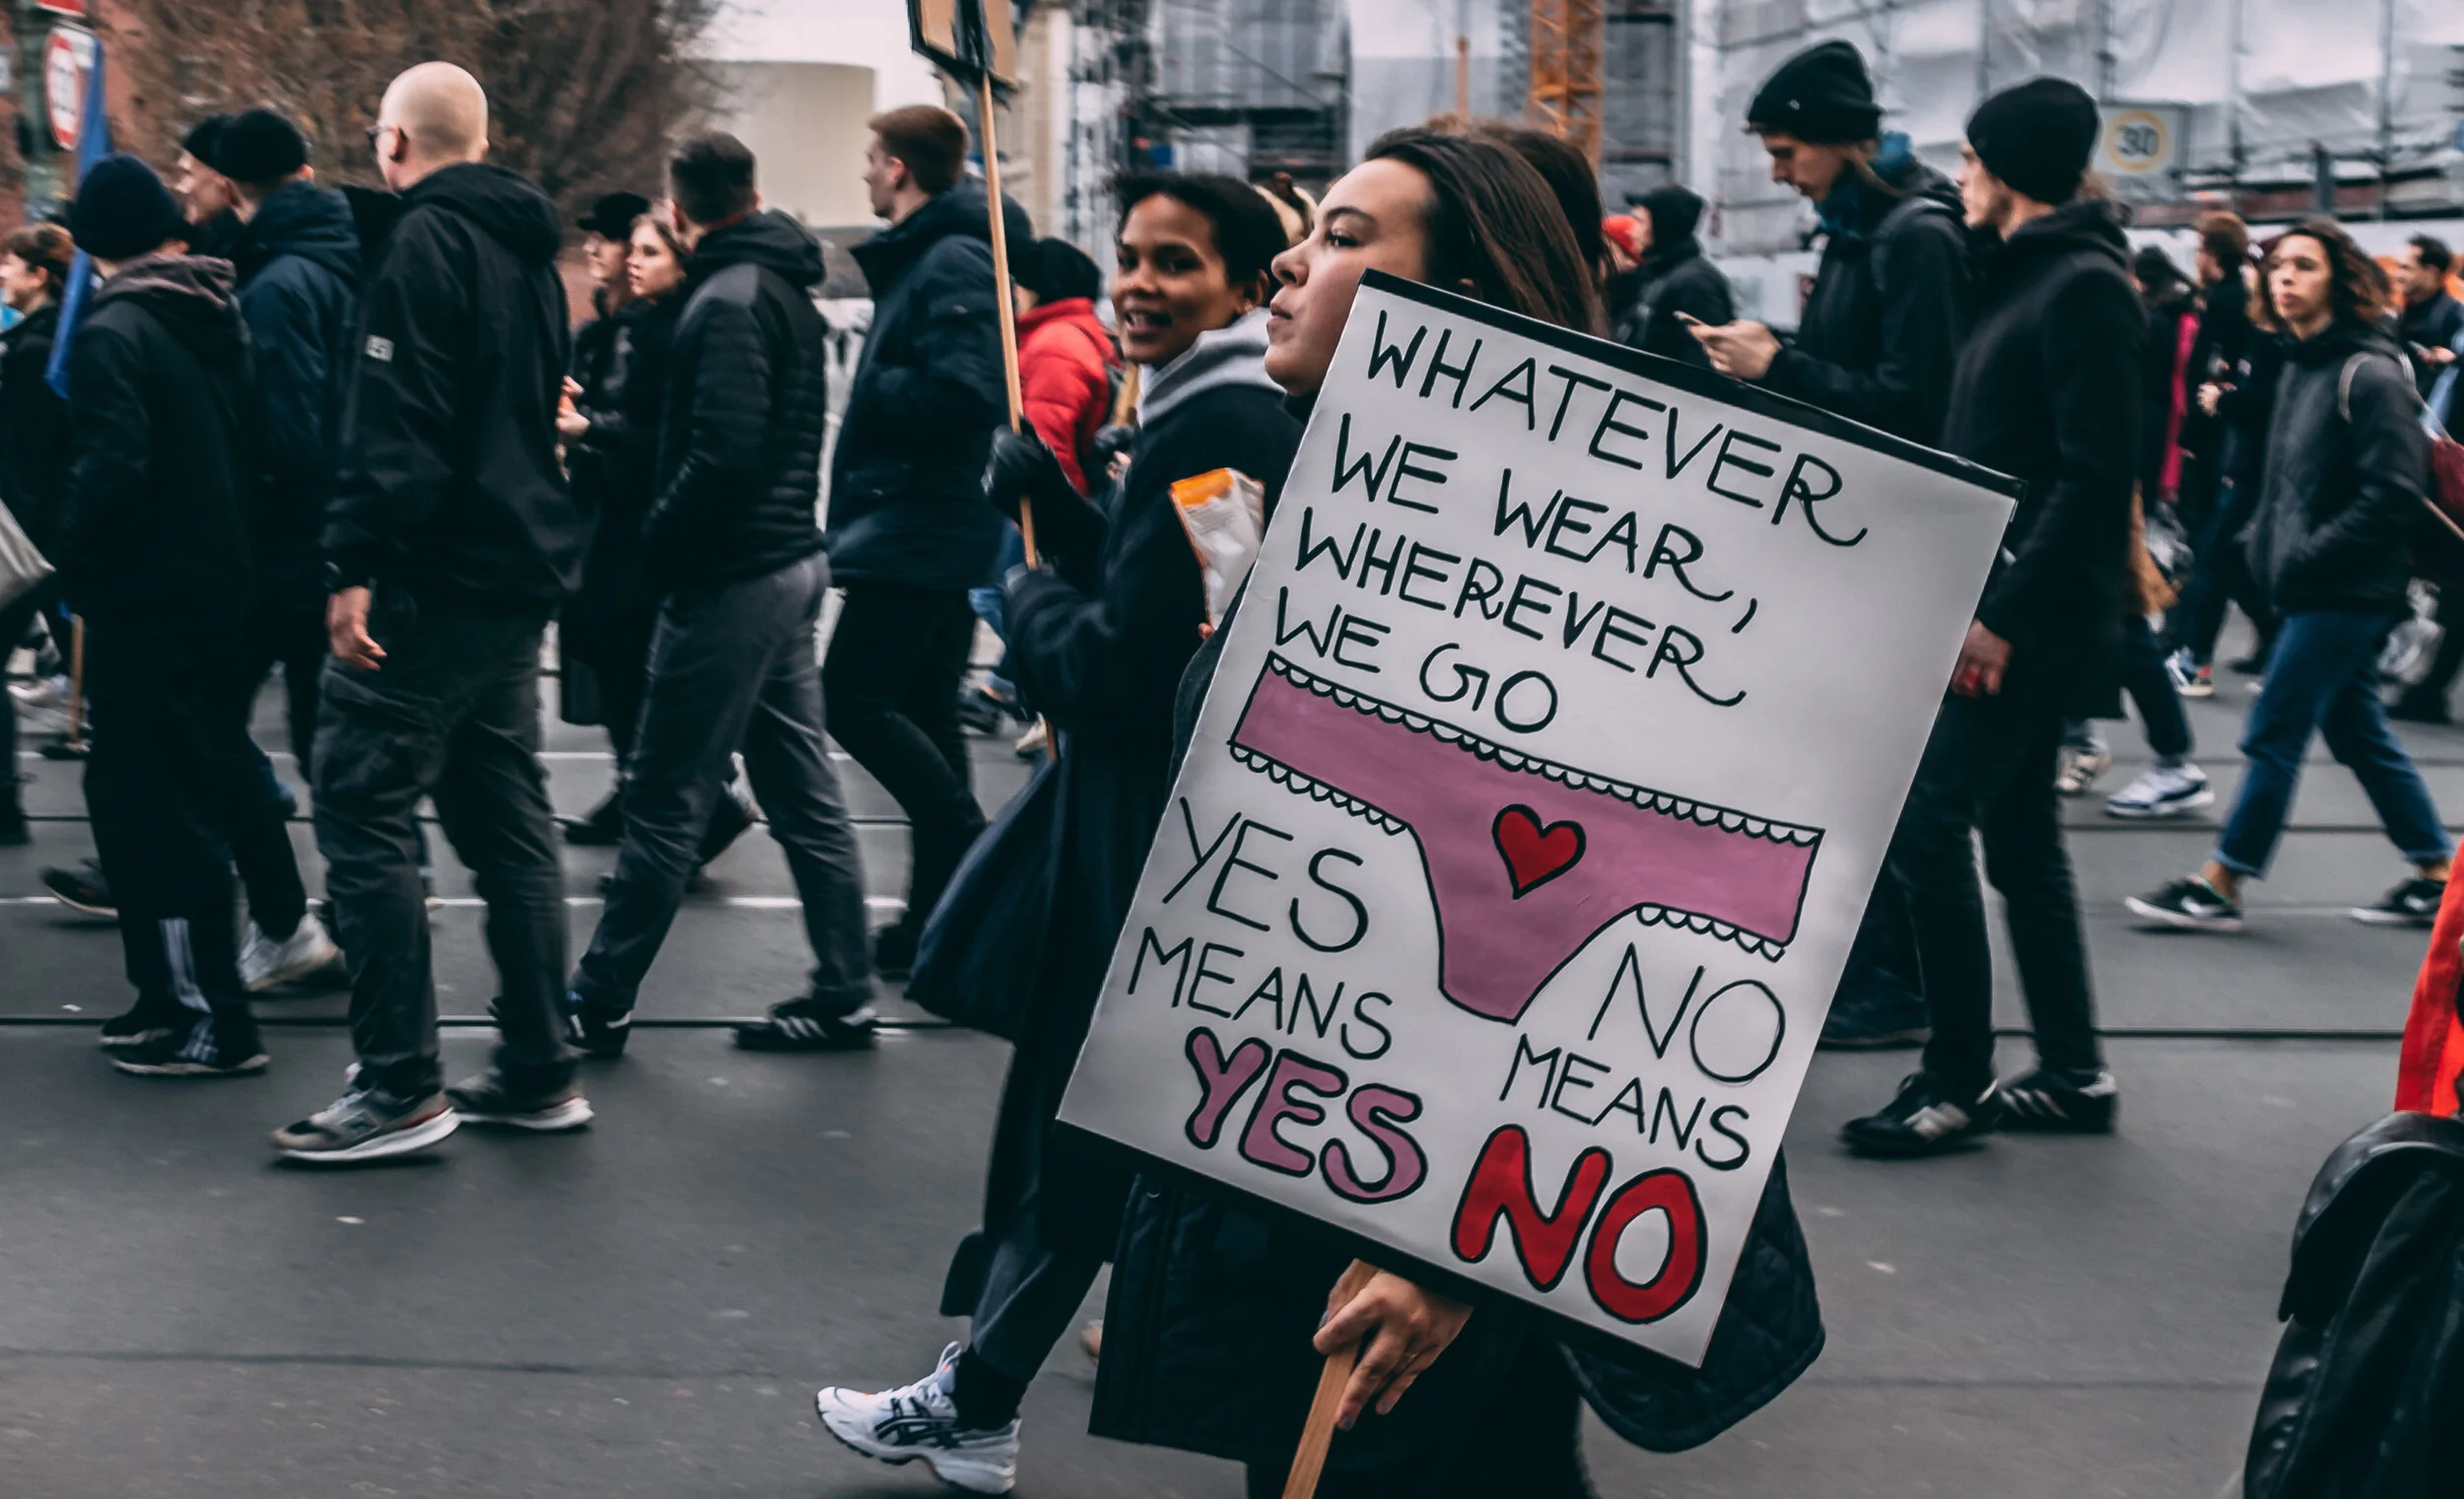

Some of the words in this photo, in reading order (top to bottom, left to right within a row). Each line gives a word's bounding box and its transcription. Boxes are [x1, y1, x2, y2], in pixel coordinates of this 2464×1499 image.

[1367, 309, 1869, 547] WHATEVER
[1332, 412, 1459, 514] WE
[1493, 467, 1758, 634] WEAR,
[1275, 585, 1392, 673] WE
[1418, 642, 1559, 733] GO
[1295, 506, 1747, 708] WHEREVER
[1162, 796, 1369, 953] YES
[1128, 926, 1393, 1059] MEANS
[1587, 942, 1787, 1084] NO
[1184, 1026, 1429, 1203] YES
[1499, 1033, 1751, 1171] MEANS
[1450, 1124, 1709, 1324] NO
